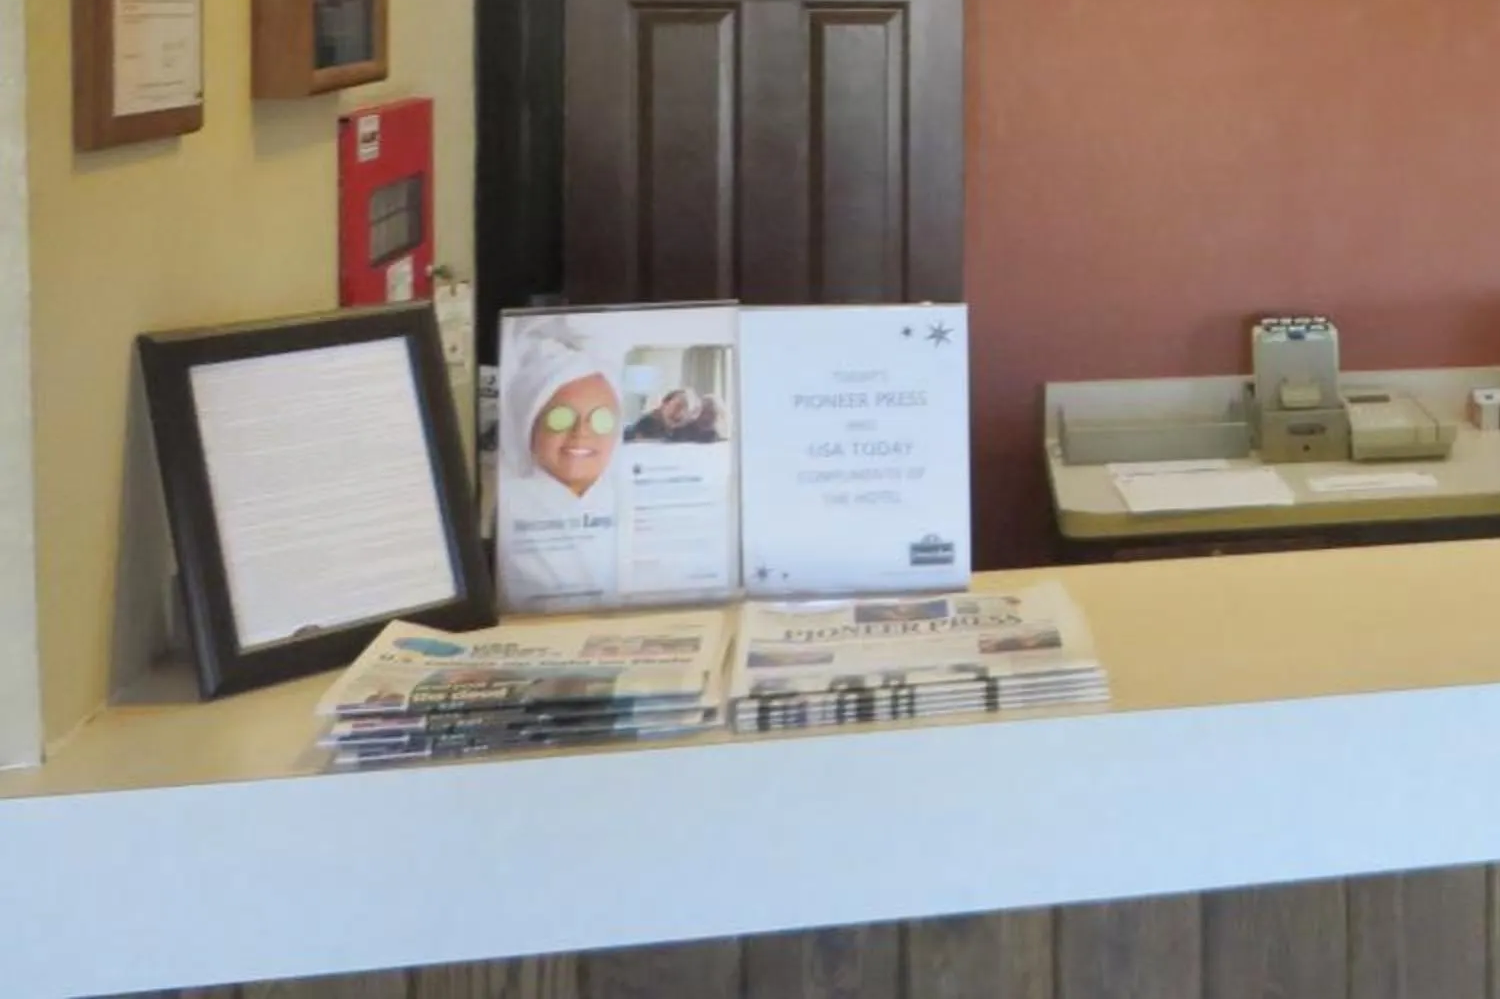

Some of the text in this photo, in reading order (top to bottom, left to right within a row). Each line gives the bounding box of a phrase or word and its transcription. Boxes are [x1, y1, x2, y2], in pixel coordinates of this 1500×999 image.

[793, 389, 929, 410] PIONEER PRESS
[806, 439, 914, 458] USA TODAY
